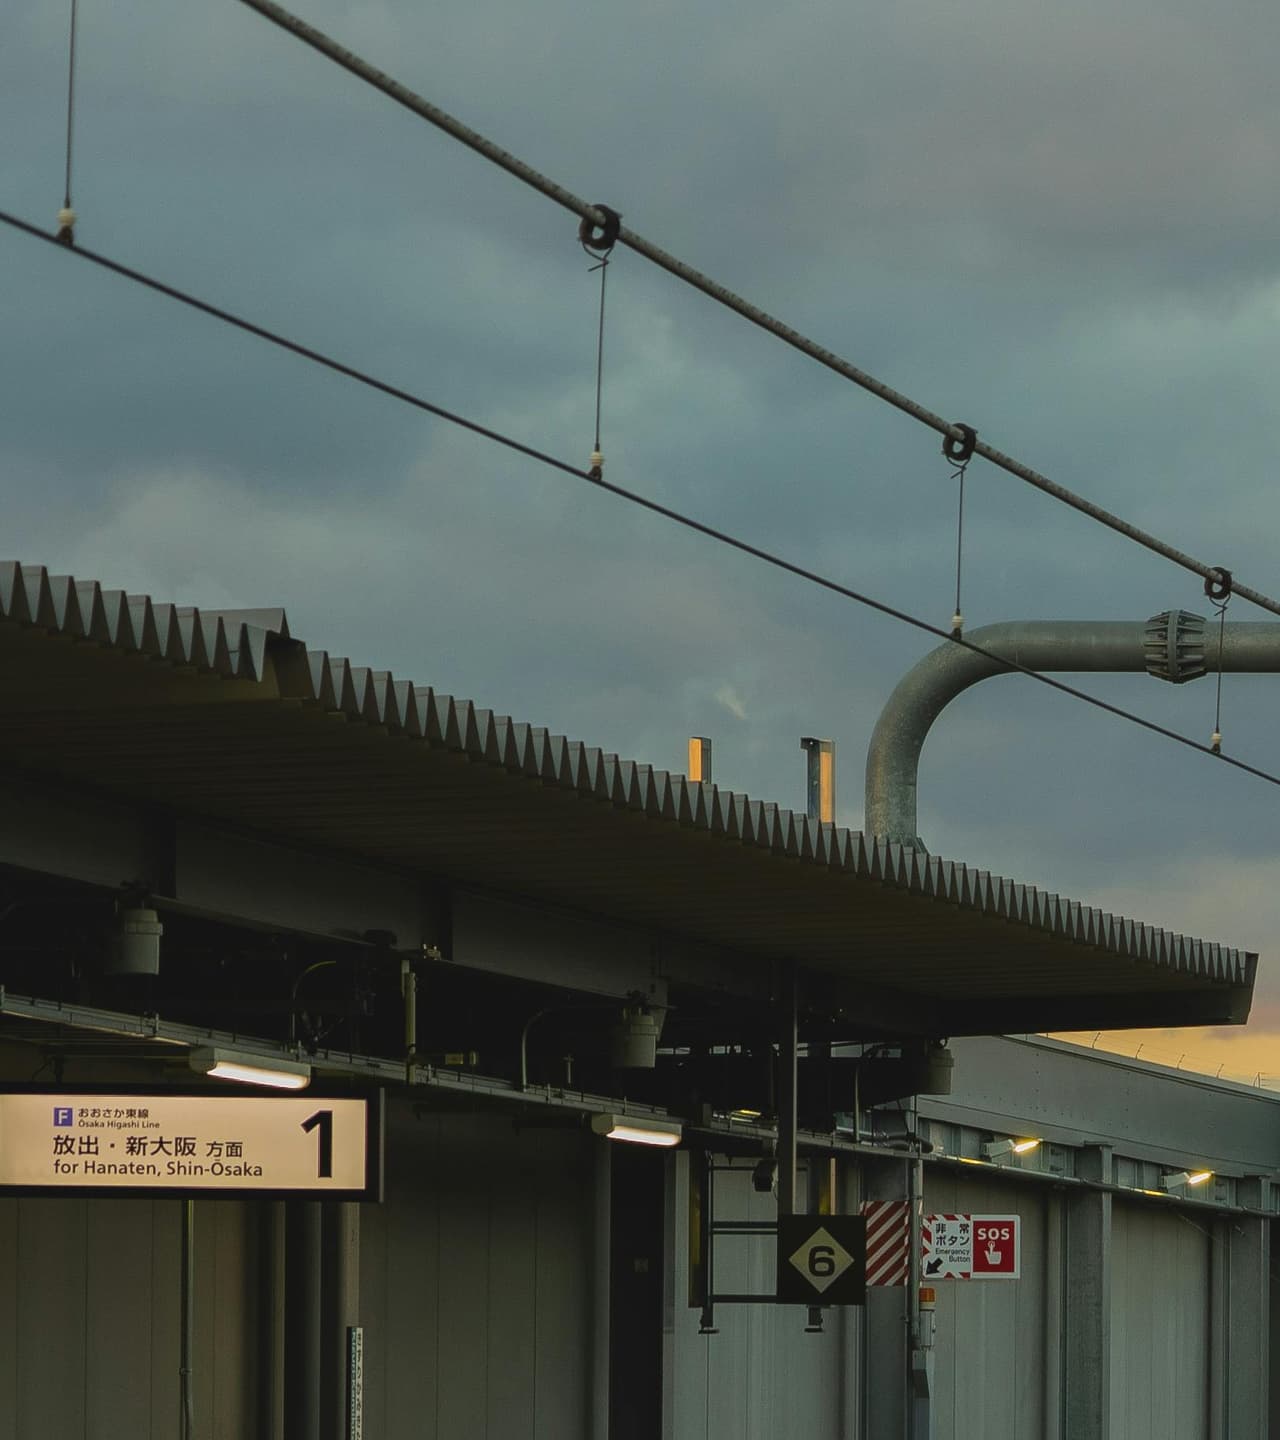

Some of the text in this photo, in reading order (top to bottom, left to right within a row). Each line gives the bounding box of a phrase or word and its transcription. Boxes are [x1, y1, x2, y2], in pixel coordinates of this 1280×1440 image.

[78, 1108, 149, 1119] おおさか東線
[107, 1119, 140, 1130] Higashi
[142, 1120, 160, 1129] Line
[53, 1135, 244, 1158] 放出・新大阪 方面
[301, 1110, 332, 1178] 1
[54, 1159, 263, 1177] for Hanaten, Shin-Ōsaka
[977, 1227, 1010, 1241] SOS
[936, 1235, 970, 1246] ボタン
[935, 1248, 970, 1256] Emergency
[808, 1245, 835, 1277] 6
[948, 1255, 971, 1263] Button
